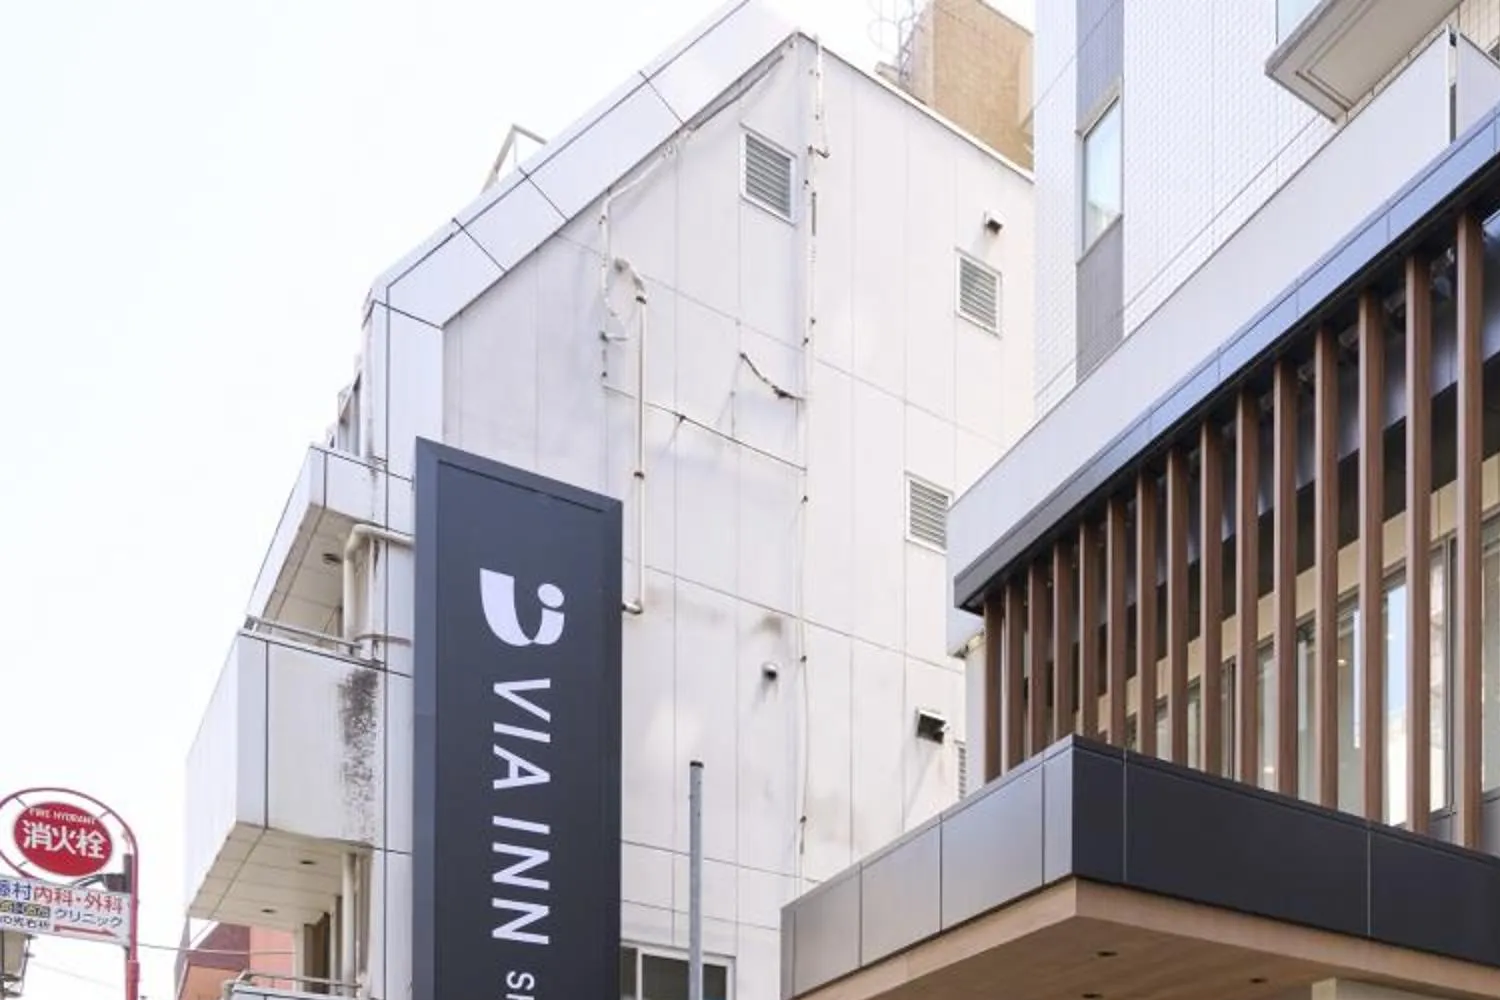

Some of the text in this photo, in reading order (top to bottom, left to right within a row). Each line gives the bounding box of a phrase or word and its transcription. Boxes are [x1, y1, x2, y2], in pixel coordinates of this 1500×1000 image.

[493, 677, 551, 790] VIA
[22, 819, 107, 859] 消火栓
[55, 907, 123, 927] クリニック
[492, 815, 550, 945] INN
